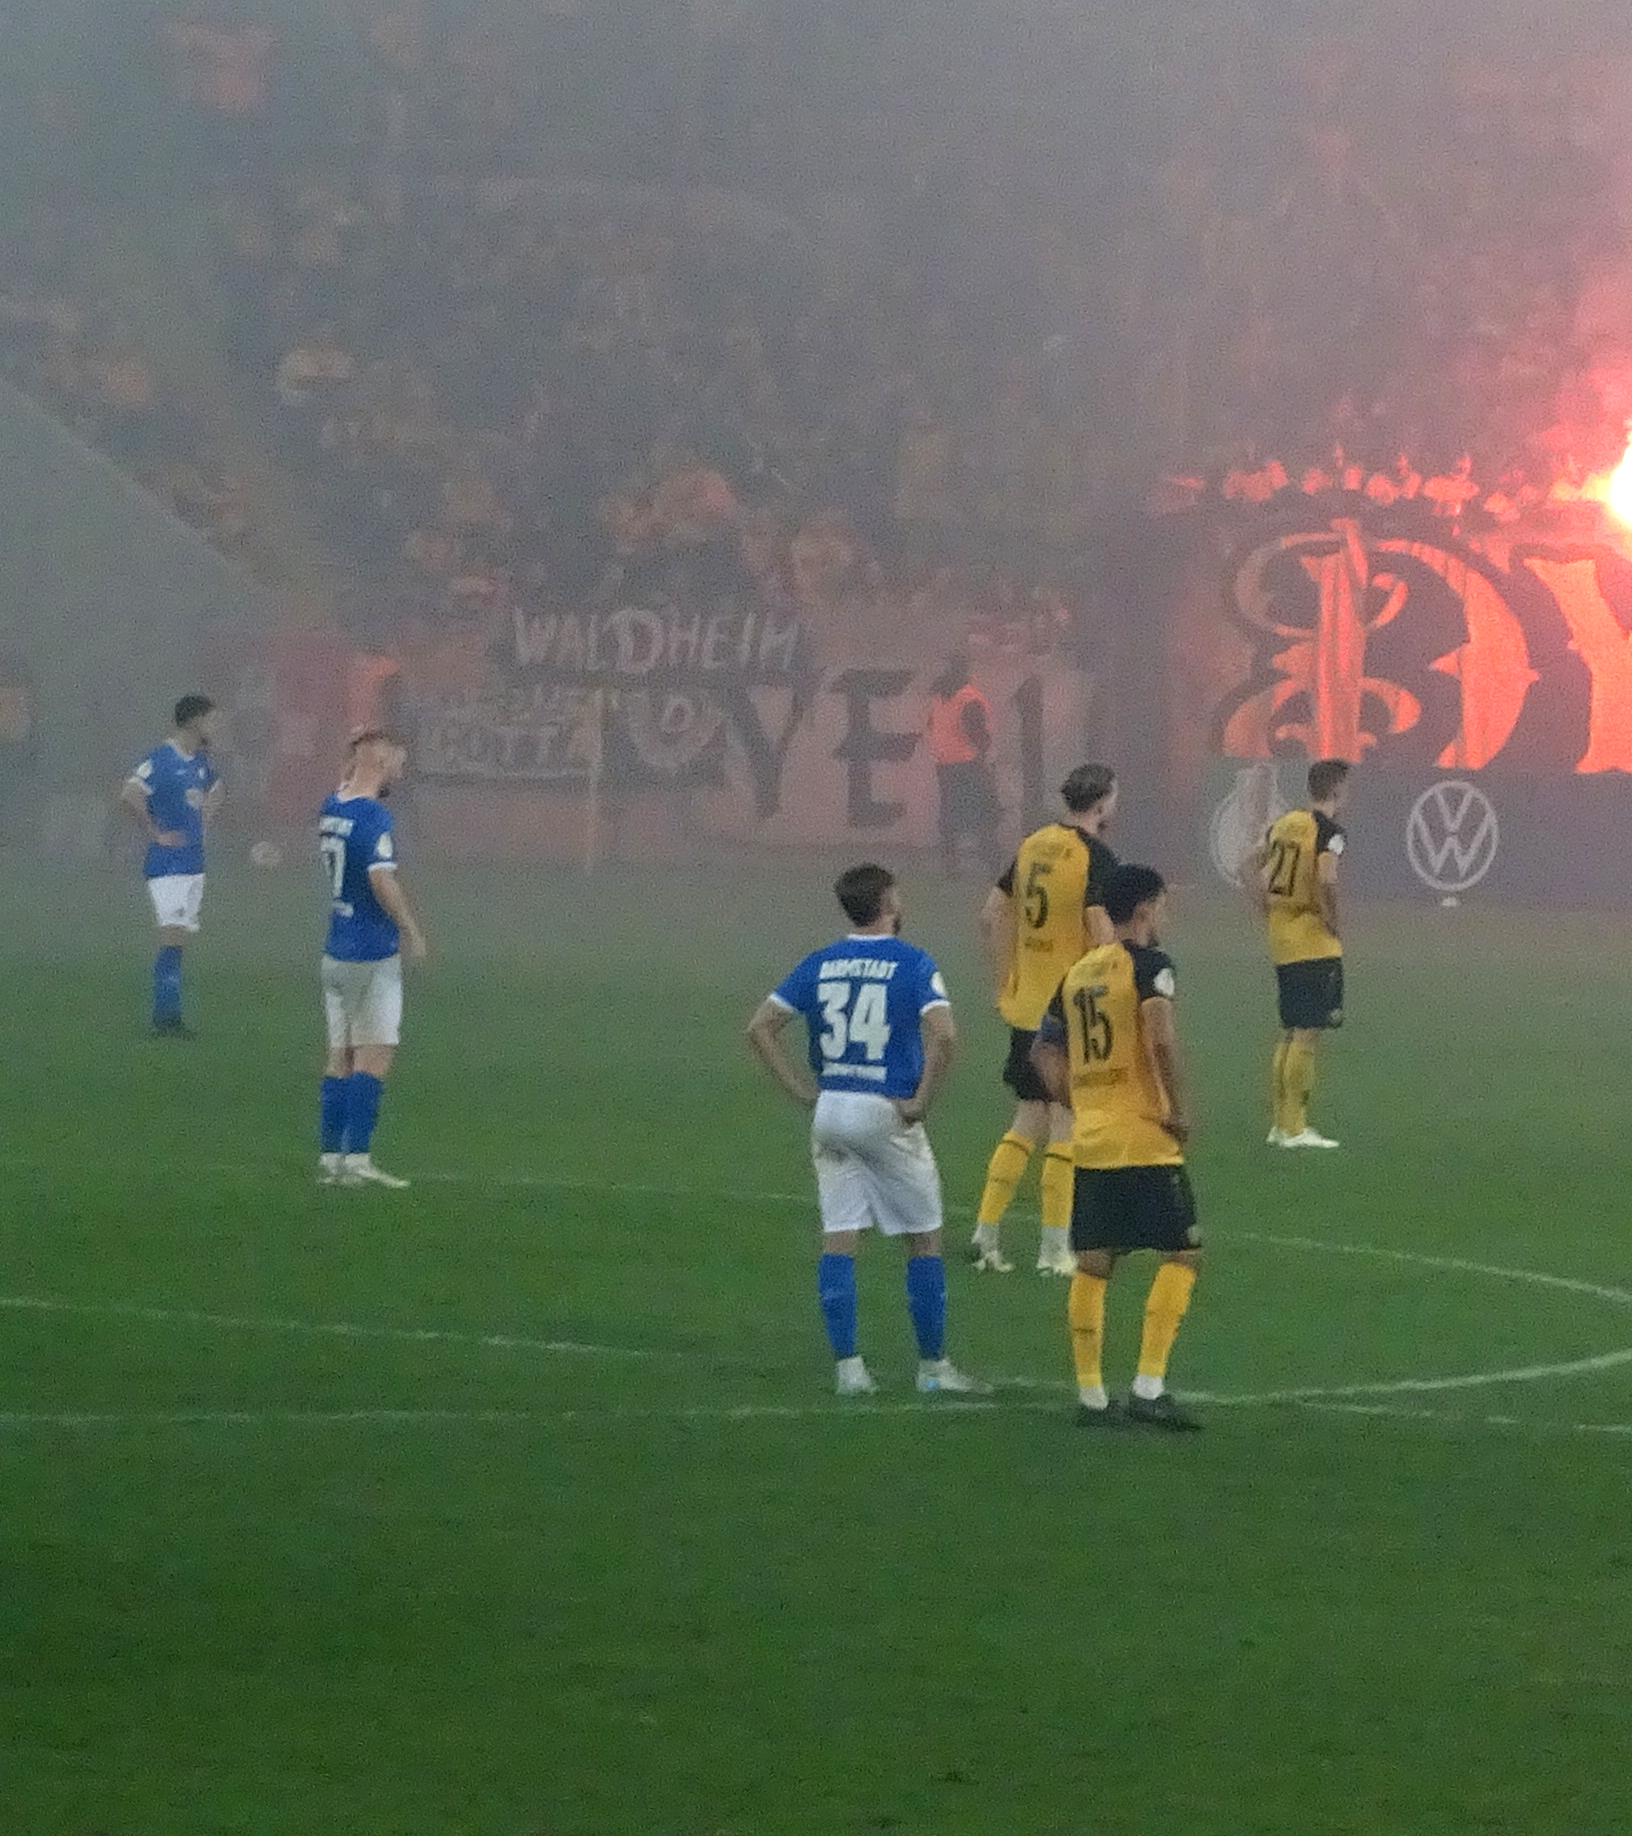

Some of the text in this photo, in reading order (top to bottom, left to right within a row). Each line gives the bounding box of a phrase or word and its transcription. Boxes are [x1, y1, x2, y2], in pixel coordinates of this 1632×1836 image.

[512, 604, 800, 675] WALDHEIM
[1024, 862, 1055, 929] 5
[1268, 840, 1299, 897] 27
[817, 981, 891, 1061] 34
[1073, 984, 1114, 1064] 15
